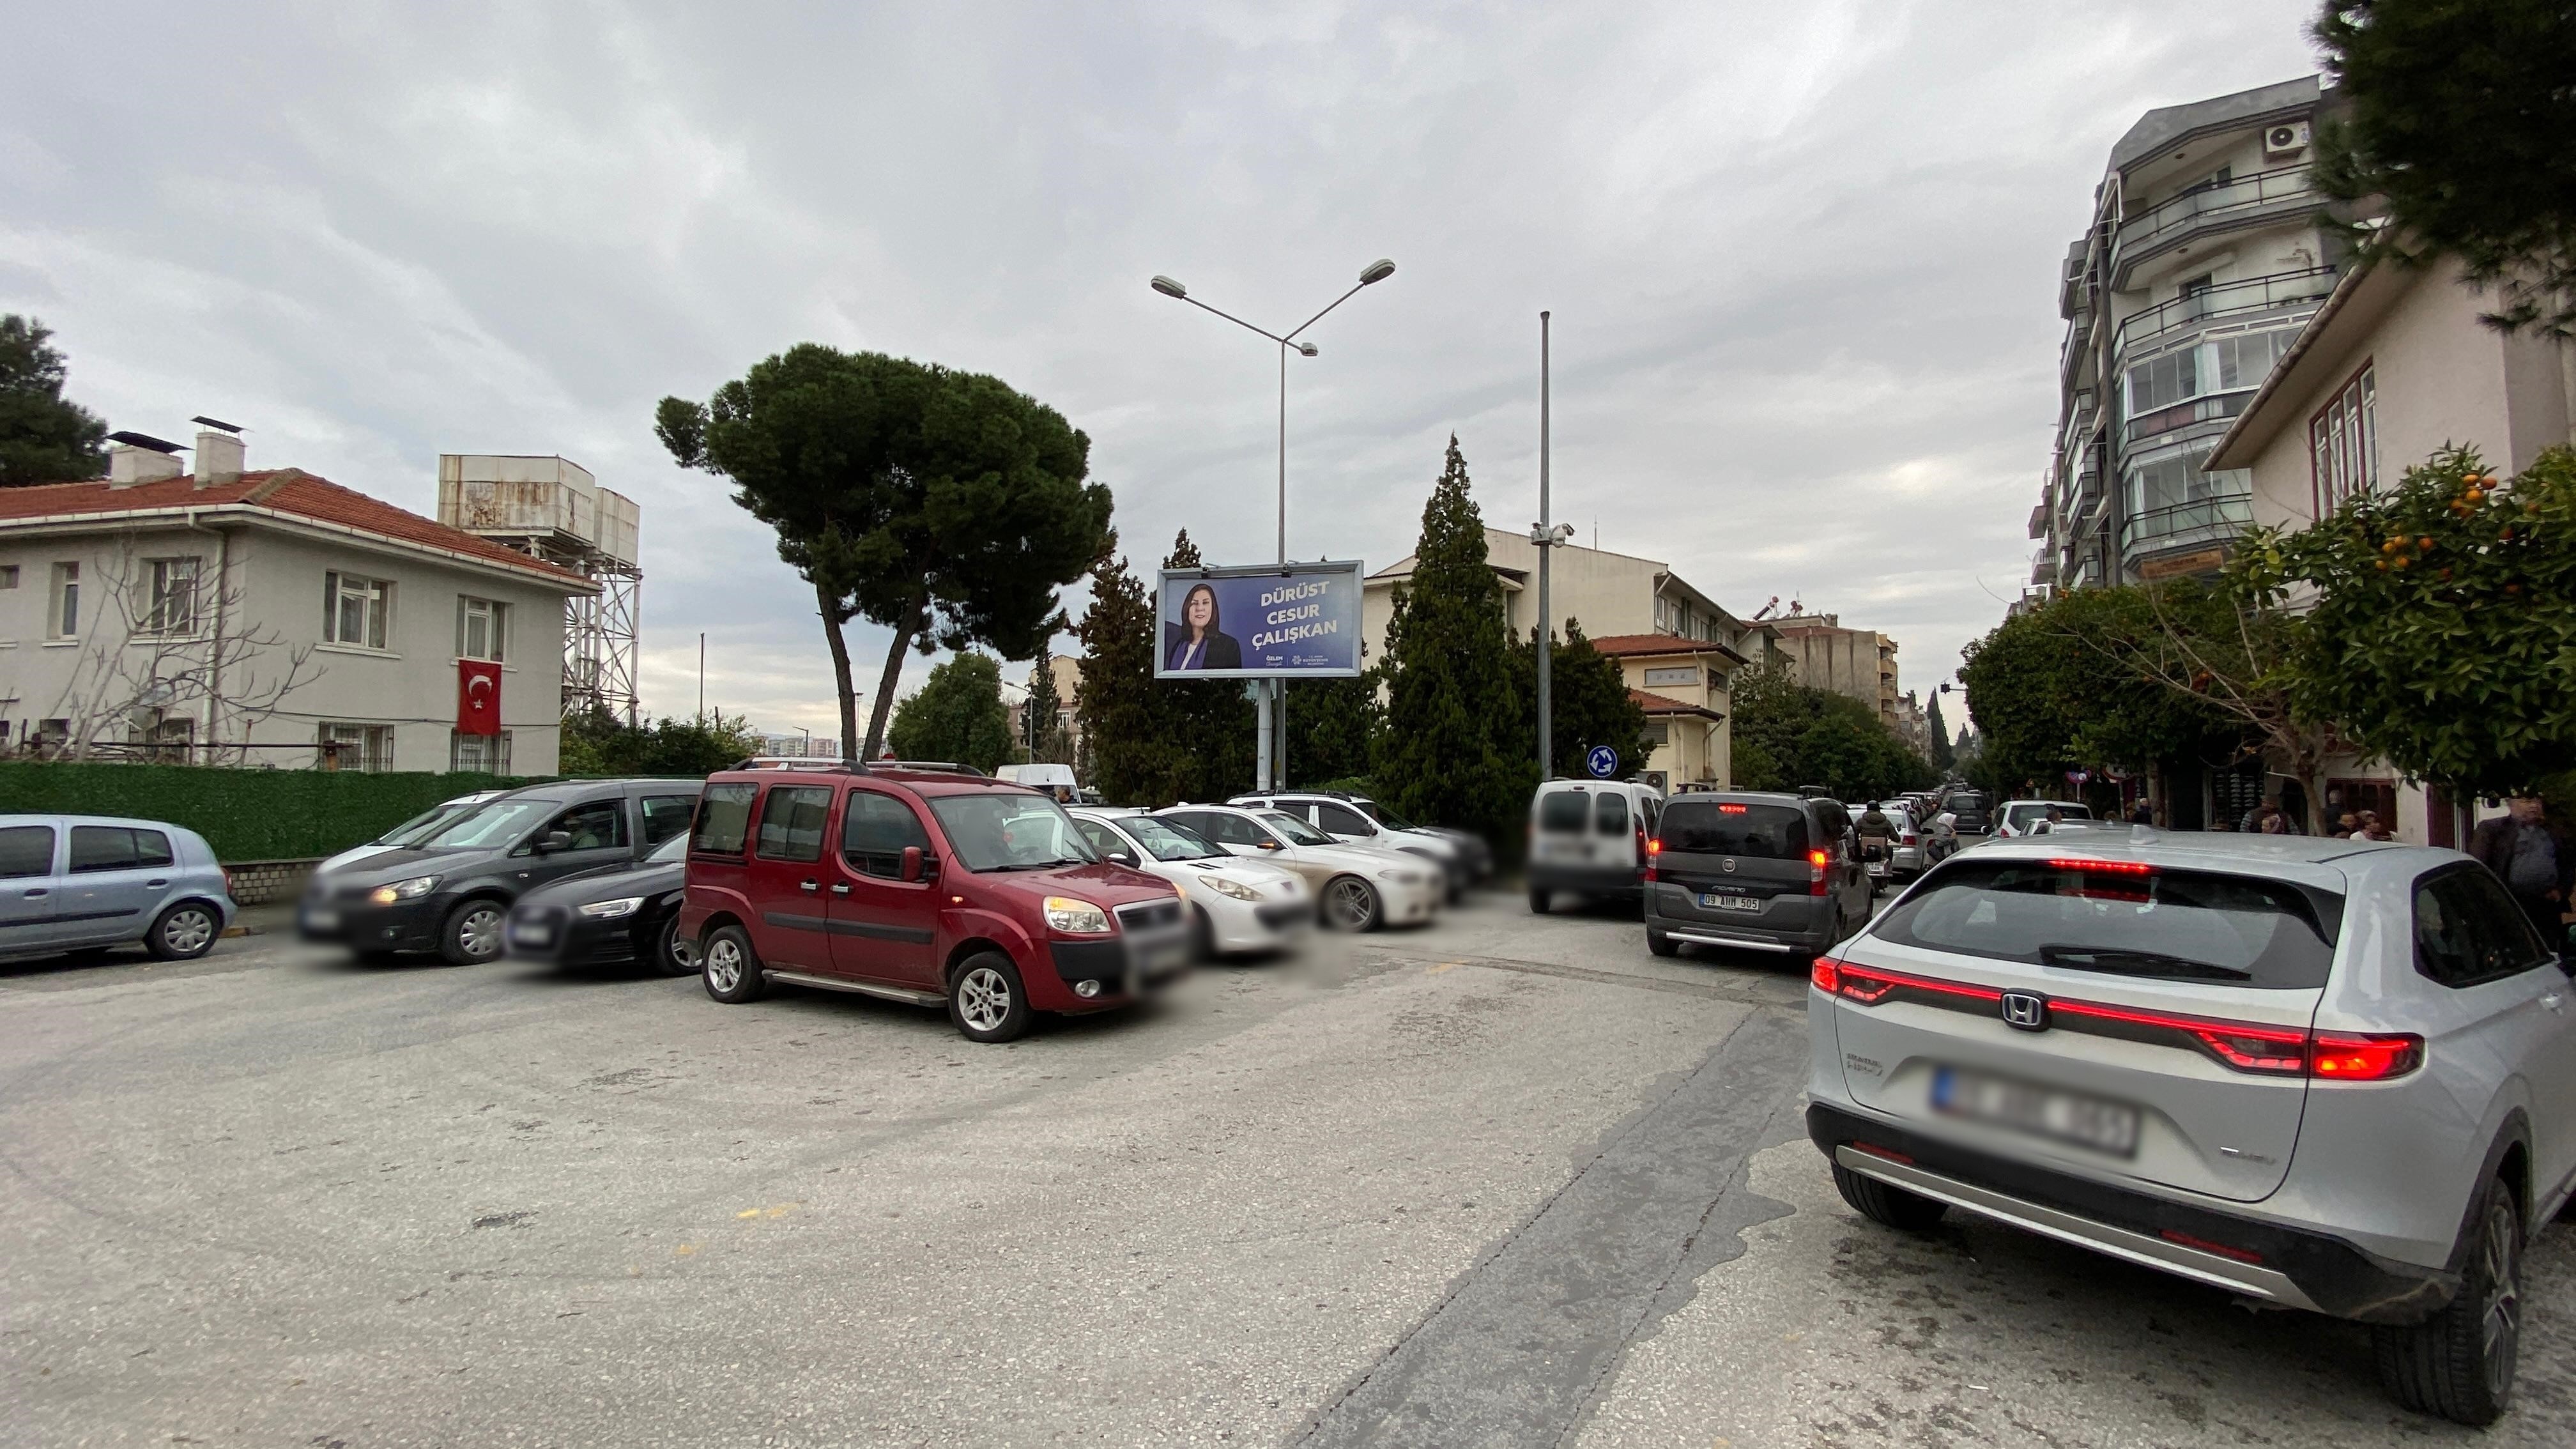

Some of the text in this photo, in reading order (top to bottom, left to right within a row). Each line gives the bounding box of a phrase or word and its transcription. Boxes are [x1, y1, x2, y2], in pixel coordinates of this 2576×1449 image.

[1261, 581, 1330, 607] DÜRÜST
[1267, 604, 1320, 625] CESUR
[1252, 620, 1337, 650] ÇALIŞKAN
[1705, 895, 1715, 904] 09
[1741, 898, 1757, 908] 505
